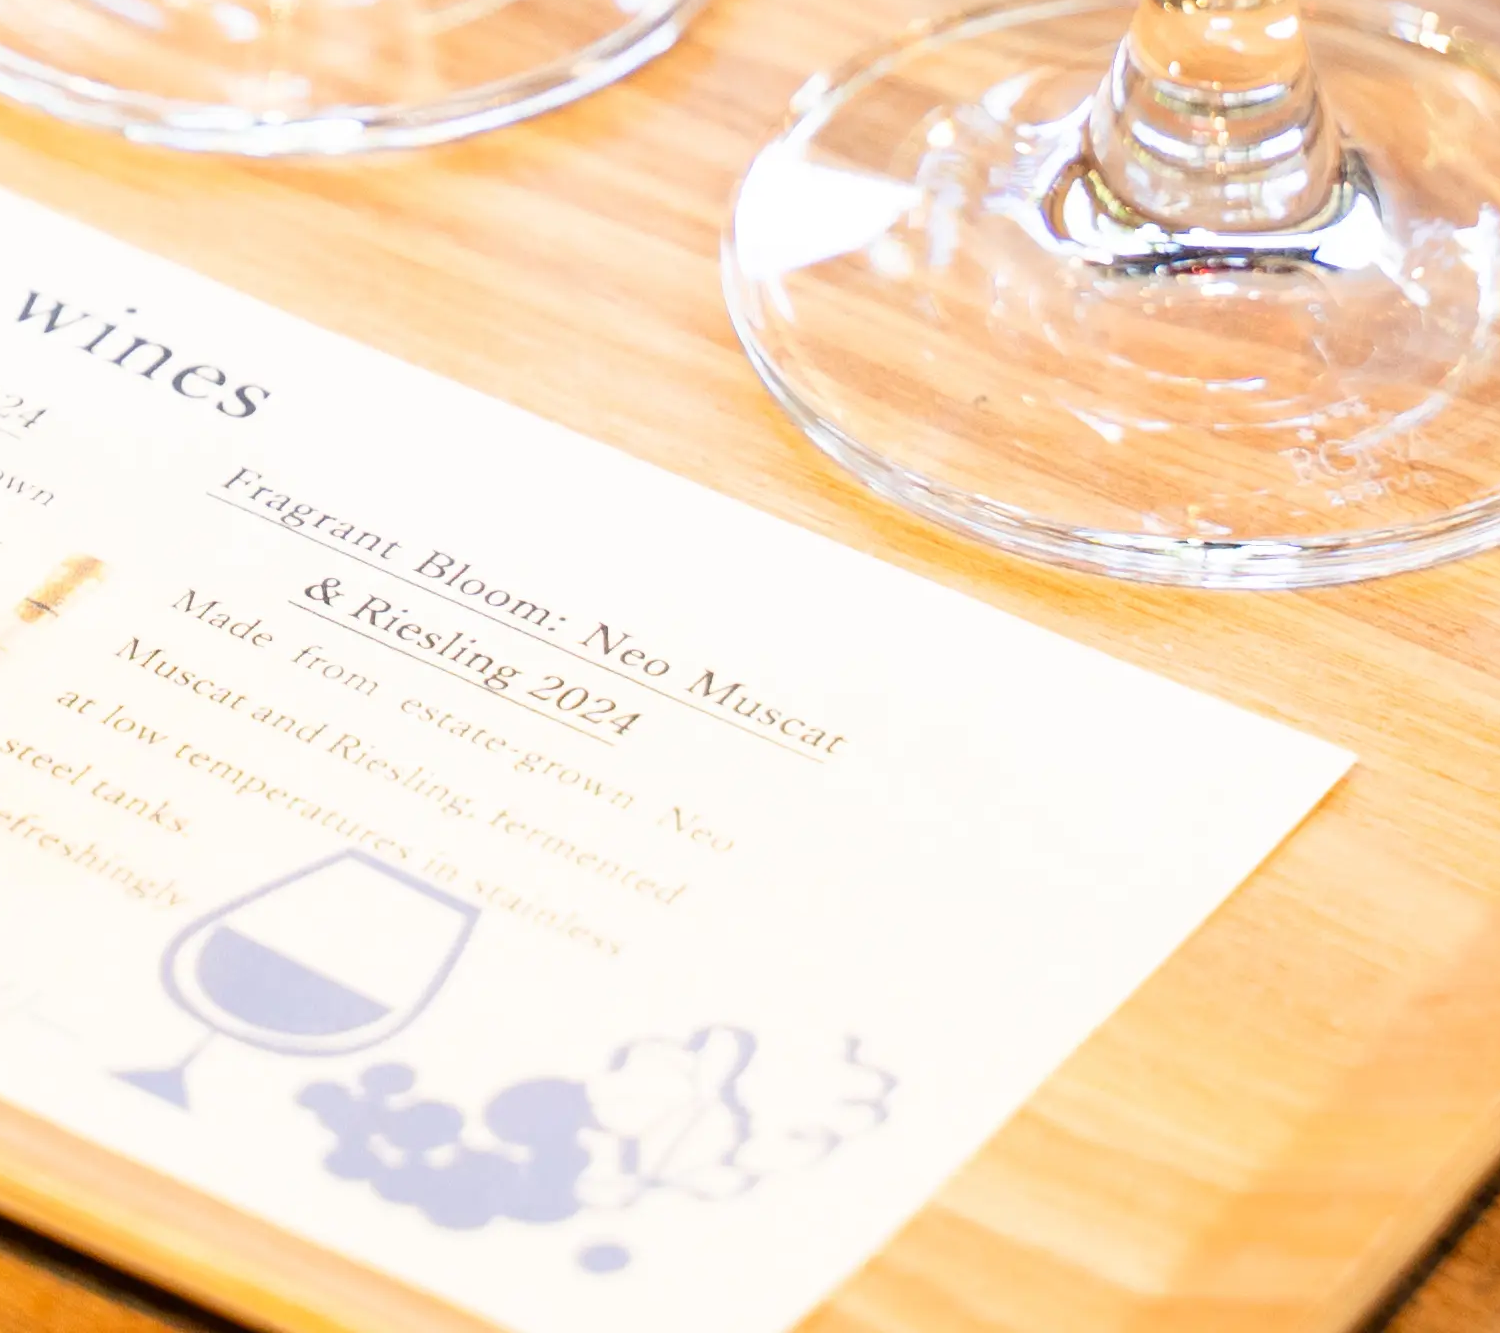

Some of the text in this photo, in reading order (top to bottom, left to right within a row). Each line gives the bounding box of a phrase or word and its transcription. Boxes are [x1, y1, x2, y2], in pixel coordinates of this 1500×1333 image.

[13, 286, 272, 420] wines
[169, 586, 738, 858] Made from estate-grown Neo
[220, 465, 850, 761] Fragrant Bloom: Neo Muscat
[301, 575, 643, 739] & Riesling 2024
[54, 683, 627, 960] at low temperatures in stainless
[93, 769, 193, 840] tanks.
[114, 634, 688, 911] Muscat and Riesling, fermented
